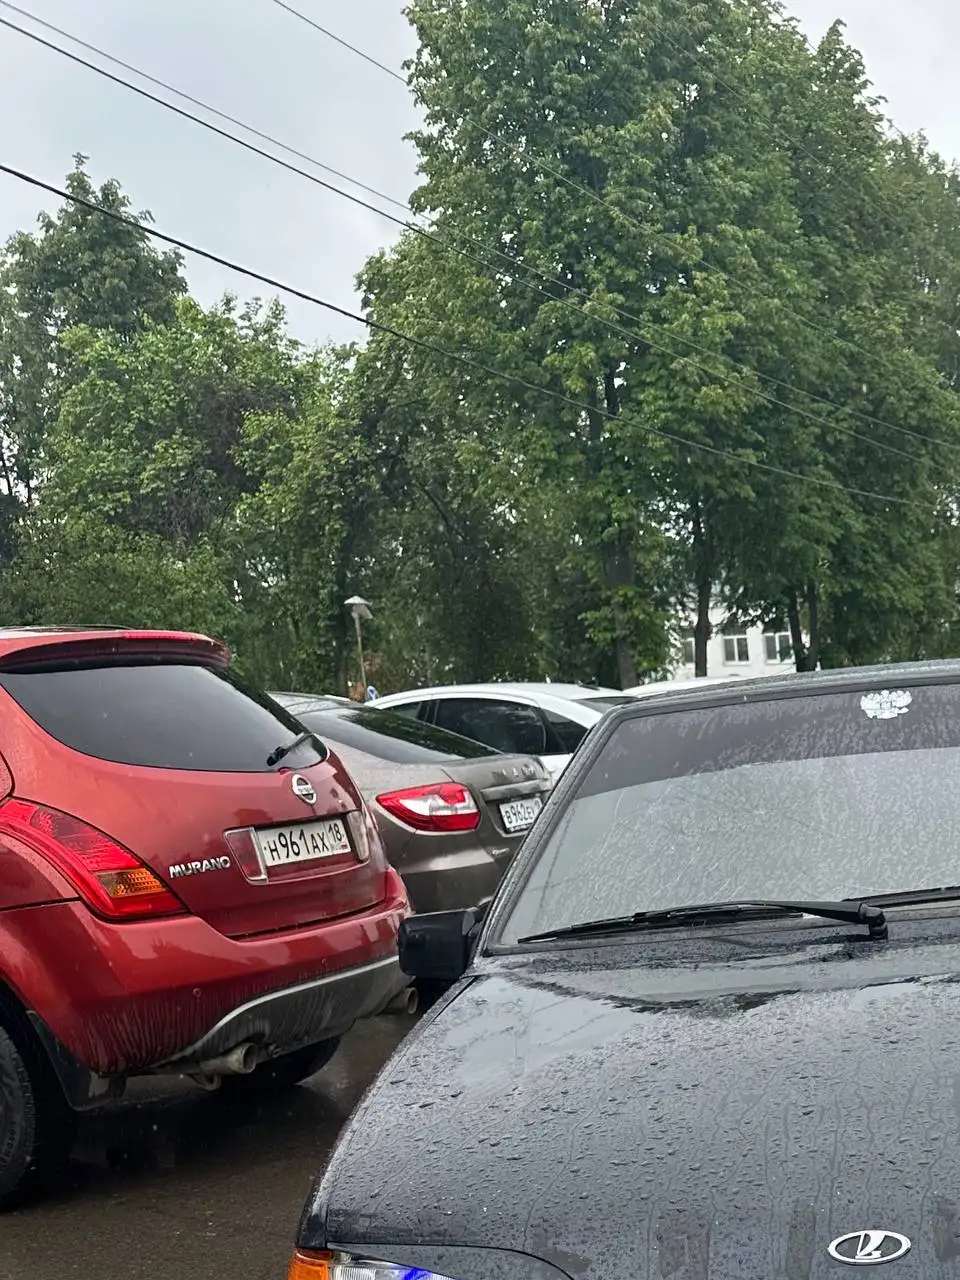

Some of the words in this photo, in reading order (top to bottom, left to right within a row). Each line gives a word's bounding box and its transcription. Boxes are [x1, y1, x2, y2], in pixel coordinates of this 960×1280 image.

[267, 829, 329, 860] Н961АХ
[328, 823, 342, 843] 18
[169, 856, 231, 878] MURANO
